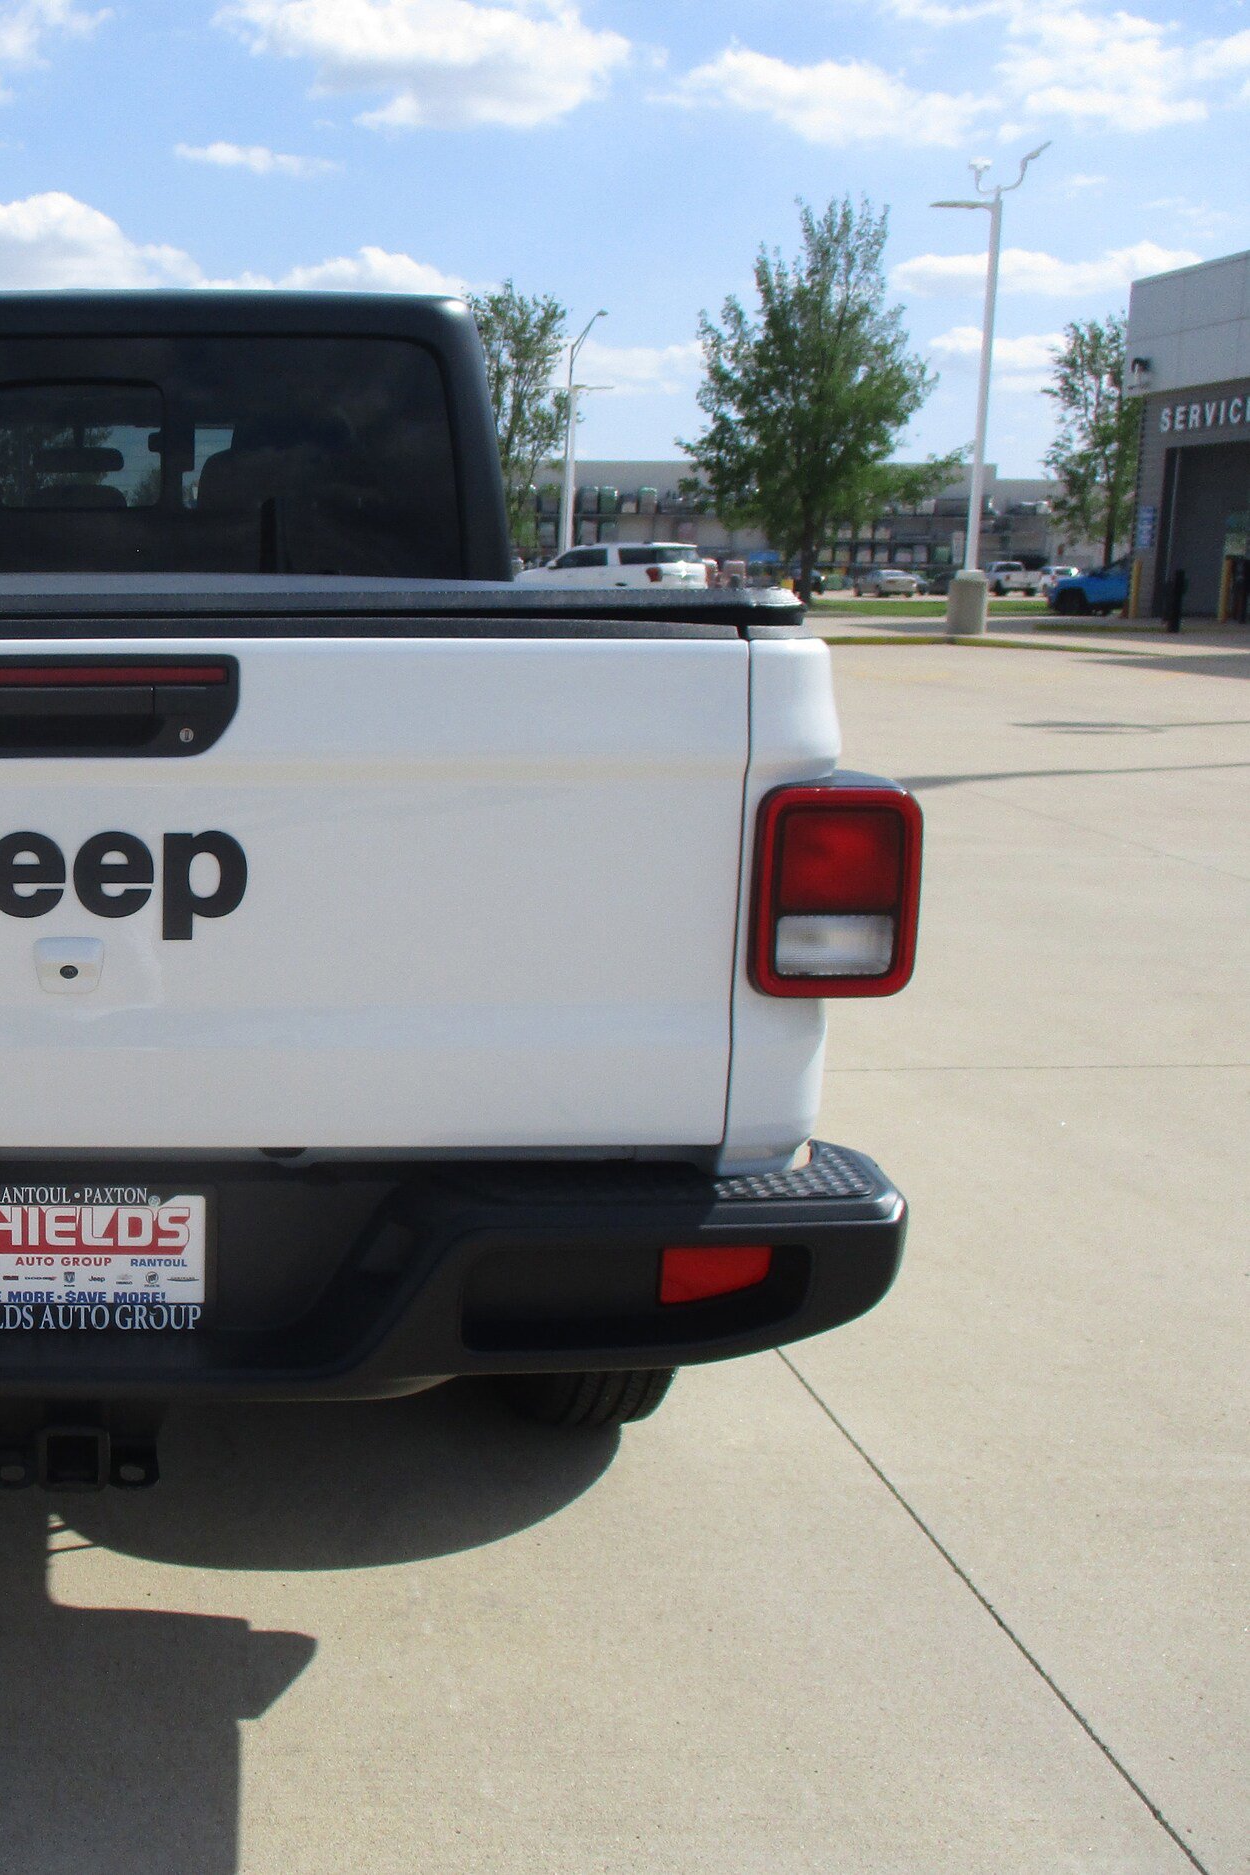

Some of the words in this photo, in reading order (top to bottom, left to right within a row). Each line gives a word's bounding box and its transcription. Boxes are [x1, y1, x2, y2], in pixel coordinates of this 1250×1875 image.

[1160, 397, 1250, 432] SERVIC
[84, 1188, 147, 1204] PAXTON
[15, 1257, 55, 1267] AUTO
[61, 1257, 112, 1267] GROUP
[130, 1258, 187, 1267] RANTOUL
[7, 1291, 55, 1302] MORE
[113, 1291, 166, 1303] MORE!
[40, 1304, 110, 1330] AUTO
[114, 1304, 201, 1330] GROUP
